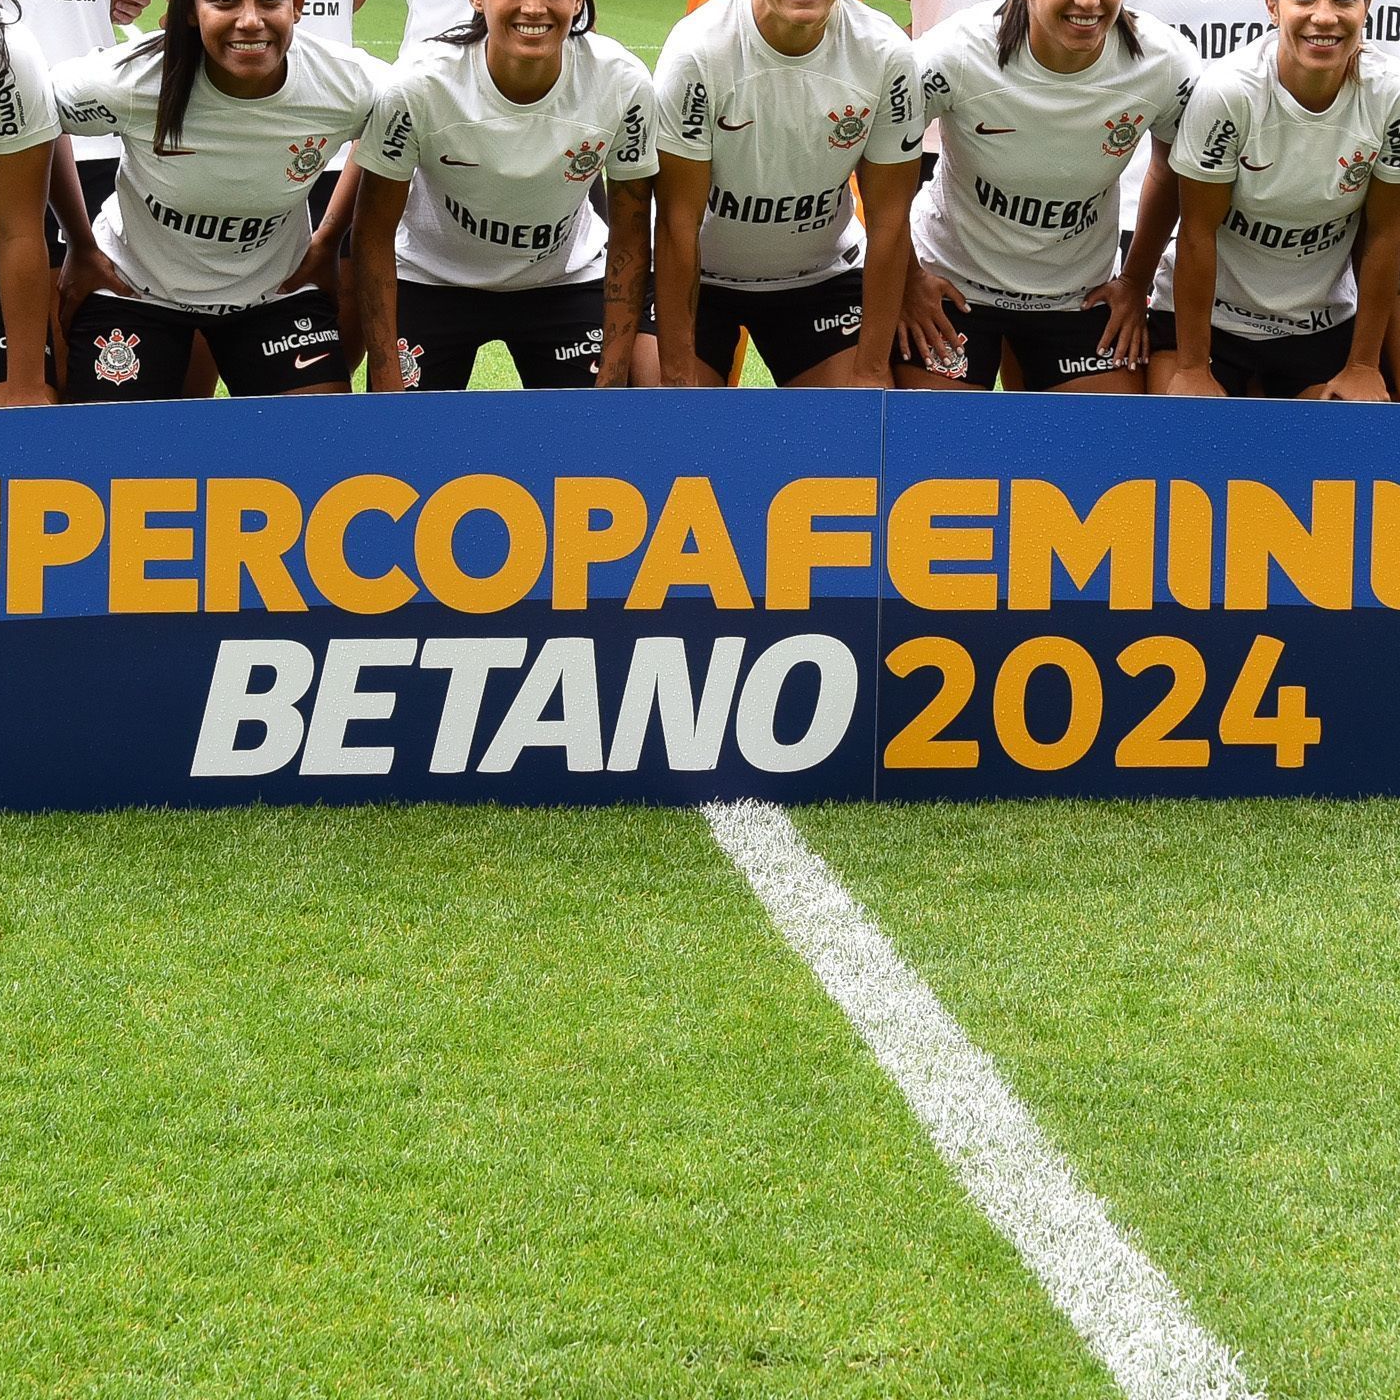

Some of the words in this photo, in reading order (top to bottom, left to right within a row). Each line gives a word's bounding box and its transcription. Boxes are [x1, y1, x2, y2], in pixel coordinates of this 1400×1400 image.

[76, 103, 117, 125] bmg
[617, 119, 646, 163] bmg
[1209, 119, 1241, 167] bmg
[975, 175, 1108, 230] VAIDEBE
[1056, 210, 1100, 244] .COM
[1297, 231, 1350, 259] .COM
[190, 634, 859, 777] BETANO
[884, 632, 1323, 771] 2024
